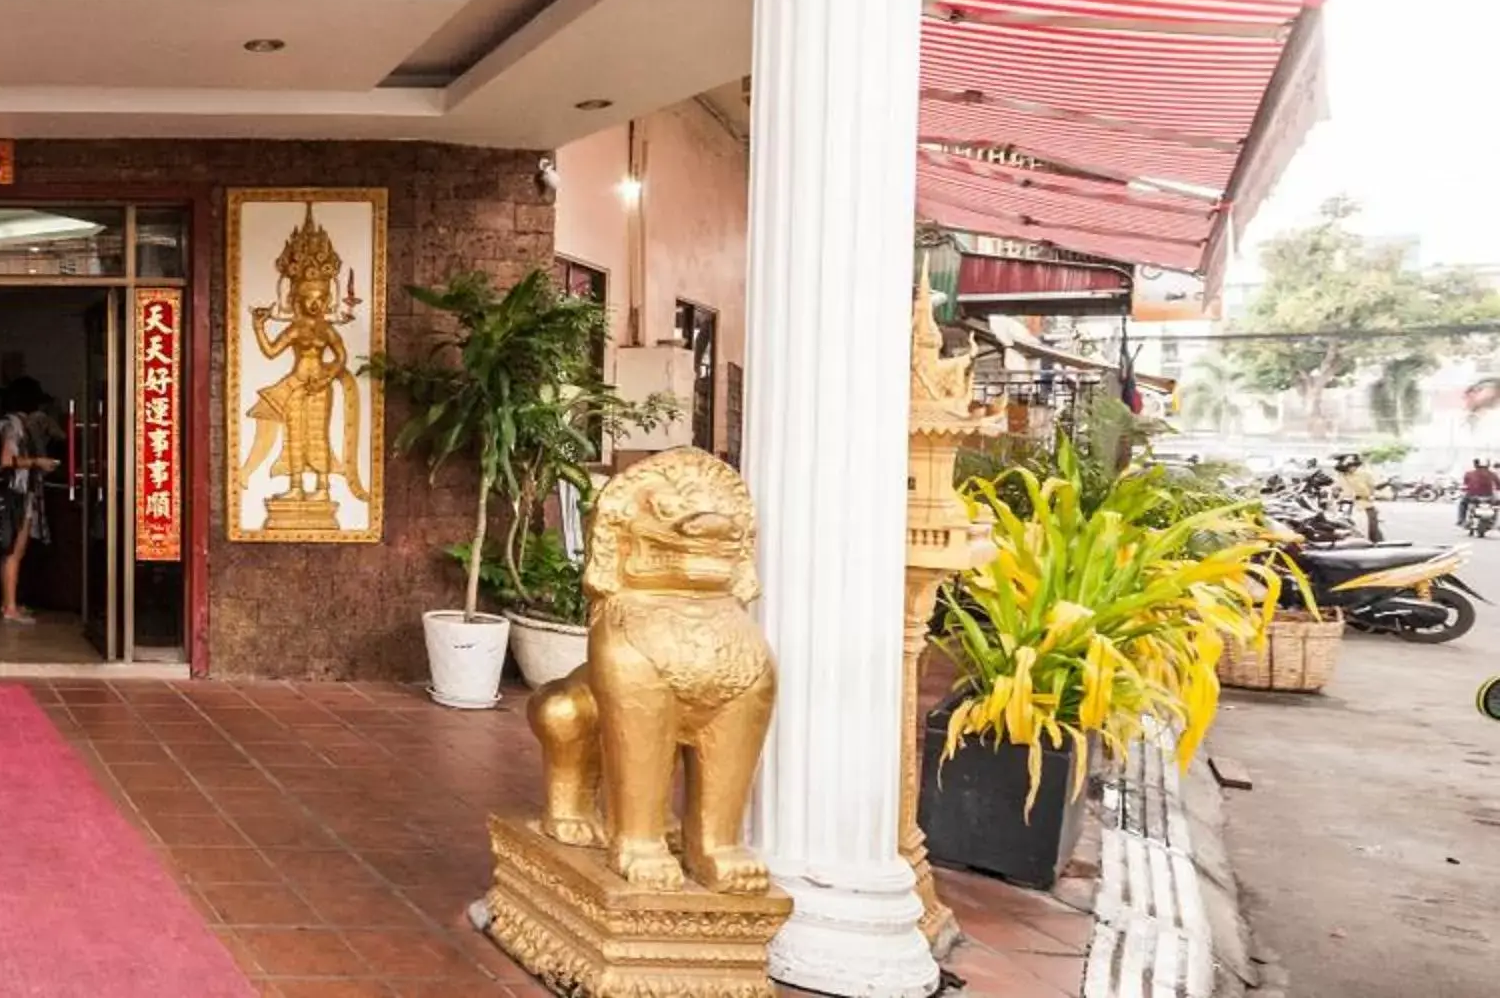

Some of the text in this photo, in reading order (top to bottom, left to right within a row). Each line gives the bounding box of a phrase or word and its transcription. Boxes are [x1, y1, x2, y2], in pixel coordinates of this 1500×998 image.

[143, 304, 173, 519] 天天好運事事順
